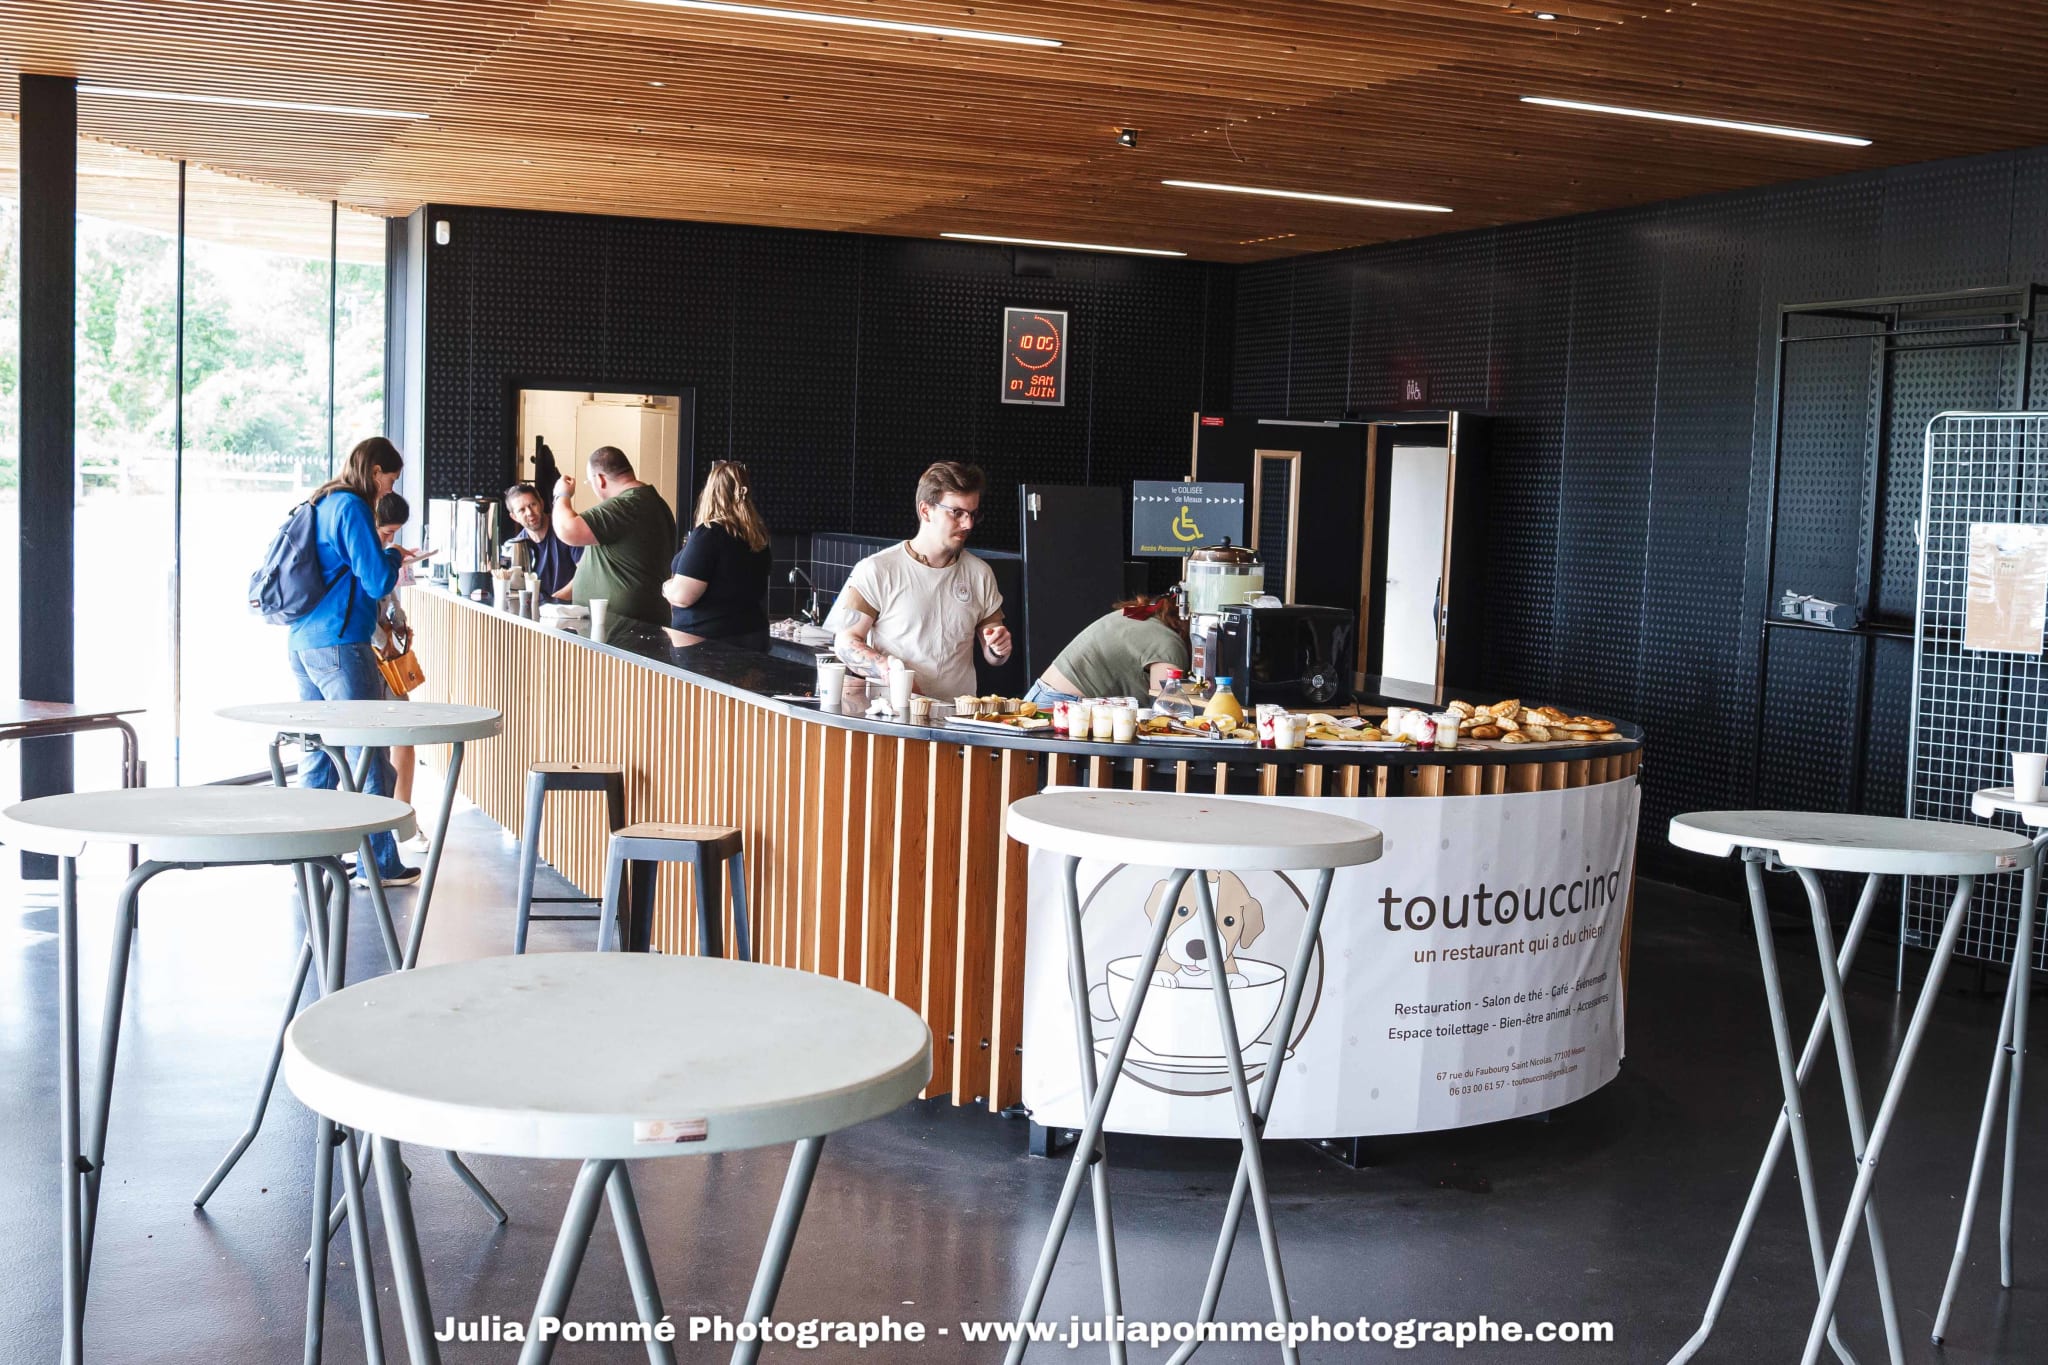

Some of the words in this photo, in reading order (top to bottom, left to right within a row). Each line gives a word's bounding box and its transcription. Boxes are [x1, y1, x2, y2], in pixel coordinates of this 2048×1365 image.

[1020, 335, 1033, 349] 10
[1036, 336, 1054, 350] 05
[1010, 380, 1023, 390] 07
[1030, 375, 1054, 386] SAM
[1025, 387, 1055, 398] JUIN
[1378, 865, 1620, 931] toutouccino
[1414, 949, 1436, 963] un
[1442, 938, 1524, 961] restaurant
[1528, 933, 1549, 955] qui
[1552, 936, 1559, 948] a
[1562, 929, 1576, 946] du
[1395, 1000, 1471, 1015] Restauration
[1482, 995, 1511, 1008] Salon
[1513, 992, 1526, 1004] de
[1528, 988, 1543, 1001] thé
[1551, 982, 1569, 997] Café
[1388, 1027, 1432, 1041] Espace
[1436, 1022, 1489, 1035] toilettage
[1499, 1013, 1544, 1029] Bien-être
[1546, 1005, 1571, 1021] animal
[1436, 1072, 1447, 1081] 67
[1449, 1072, 1463, 1080] rue
[1464, 1068, 1474, 1078] du
[1475, 1064, 1510, 1076] Faubourg
[1511, 1061, 1529, 1071] Saint
[1449, 1087, 1460, 1096] 06
[1462, 1085, 1472, 1094] 03
[1473, 1083, 1483, 1093] 00
[1484, 1081, 1493, 1091] 61
[1495, 1080, 1505, 1089] 57
